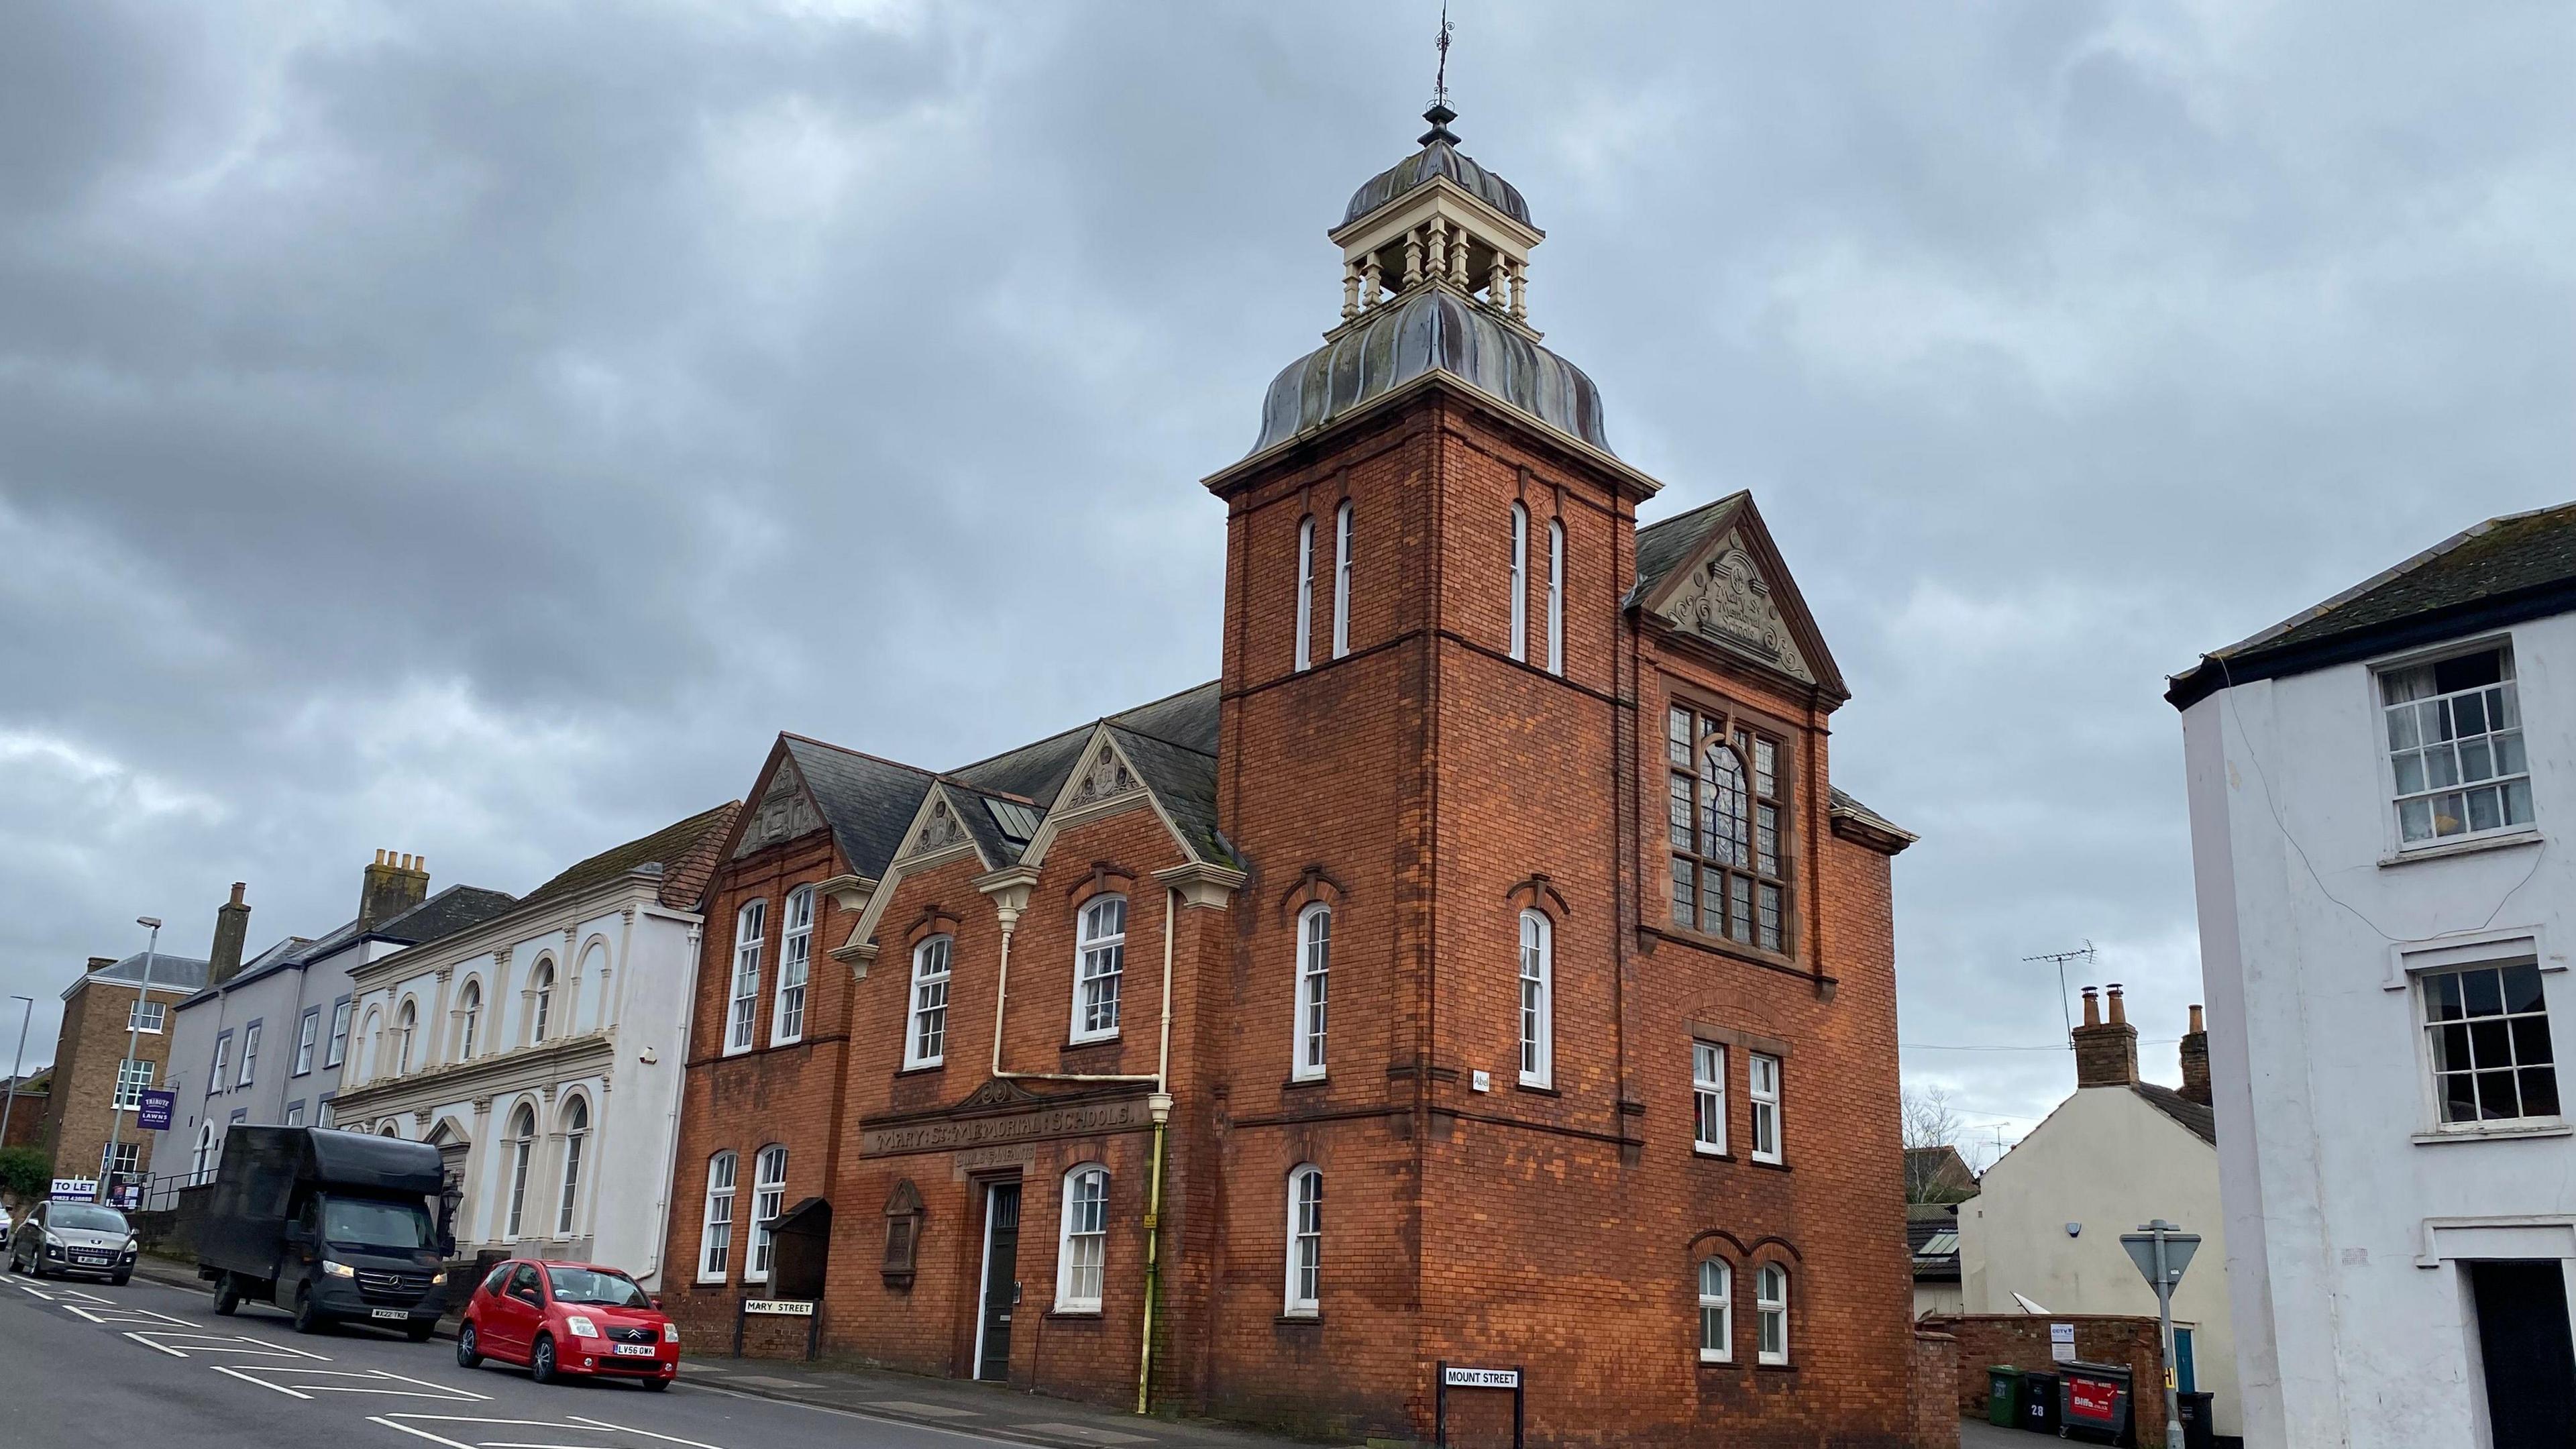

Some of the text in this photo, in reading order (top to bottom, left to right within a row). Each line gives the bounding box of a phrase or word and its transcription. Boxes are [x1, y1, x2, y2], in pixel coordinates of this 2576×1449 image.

[1474, 1075, 1489, 1087] Abel
[144, 1097, 170, 1107] TRIBUTE
[55, 1182, 95, 1191] TO LET
[747, 1302, 810, 1312] MARY STREET
[618, 1346, 653, 1355] LV56 OWK
[1448, 1371, 1515, 1384] MOUNT STREET
[2031, 1405, 2043, 1416] 28
